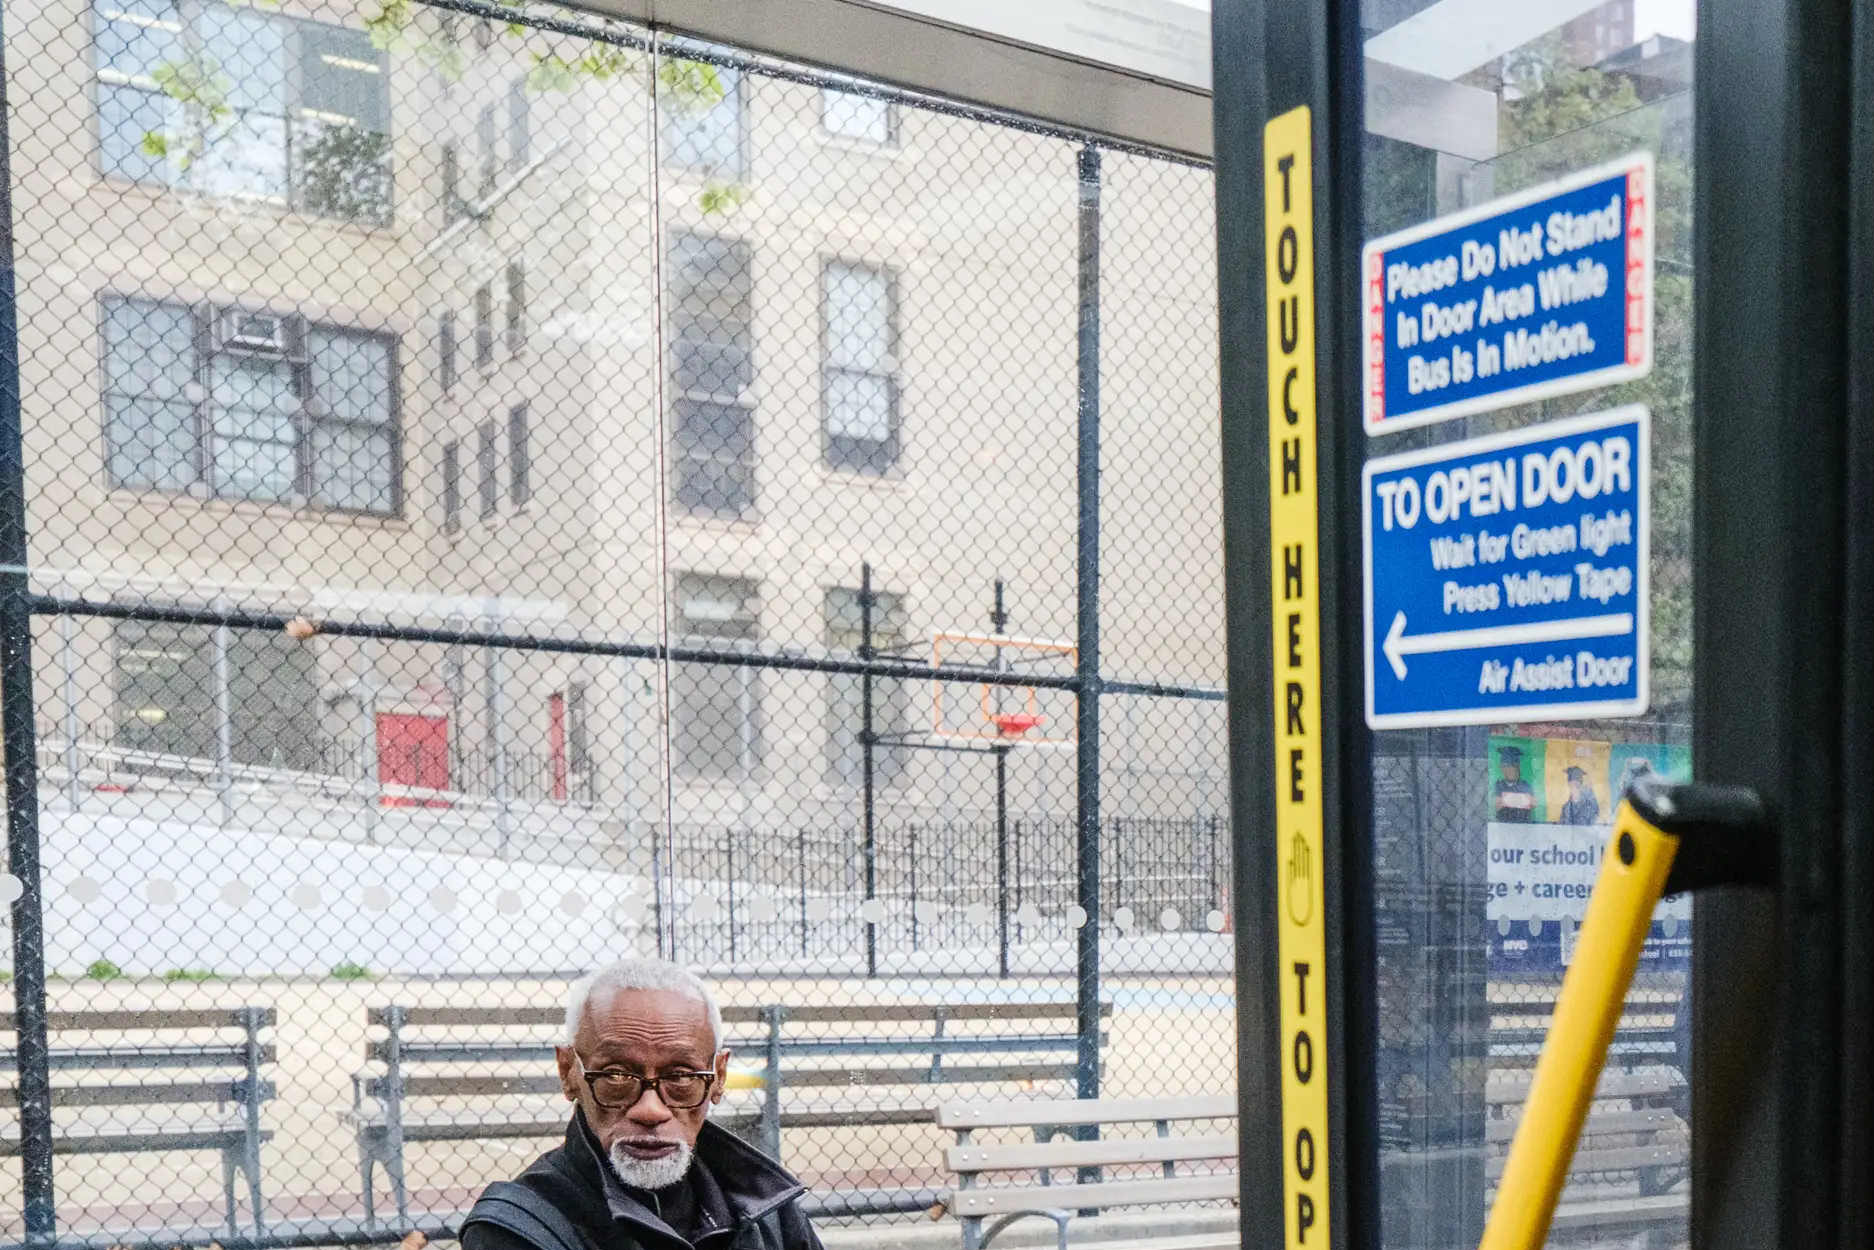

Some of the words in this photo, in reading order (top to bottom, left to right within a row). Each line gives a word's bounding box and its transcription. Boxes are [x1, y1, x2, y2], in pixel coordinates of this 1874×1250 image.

[1387, 255, 1458, 303] Please
[1461, 240, 1495, 281] Do
[1499, 222, 1544, 271] Not
[1546, 194, 1622, 256] Stand
[1277, 153, 1300, 496] TOUCH
[1397, 312, 1418, 349] In
[1422, 299, 1477, 343] Door
[1479, 283, 1535, 328] Area
[1538, 258, 1609, 311] While
[1408, 355, 1450, 395] Bus
[1452, 345, 1474, 384] Is
[1477, 338, 1500, 378] In
[1504, 320, 1596, 371] Motion.
[1377, 476, 1420, 532] TO
[1425, 458, 1516, 525] OPEN
[1522, 436, 1631, 509] DOOR
[1430, 533, 1475, 571] Wait
[1478, 530, 1508, 565] for
[1511, 522, 1576, 560] Green
[1443, 580, 1500, 615] Press
[1502, 569, 1572, 608] Yellow
[1574, 562, 1632, 605] Tape
[1284, 544, 1305, 803] HERE
[1478, 658, 1508, 694] Air
[1510, 654, 1573, 693] Assist
[1576, 650, 1632, 688] Door
[1491, 848, 1524, 864] our
[1530, 844, 1595, 865] school
[1294, 961, 1313, 1086] TO
